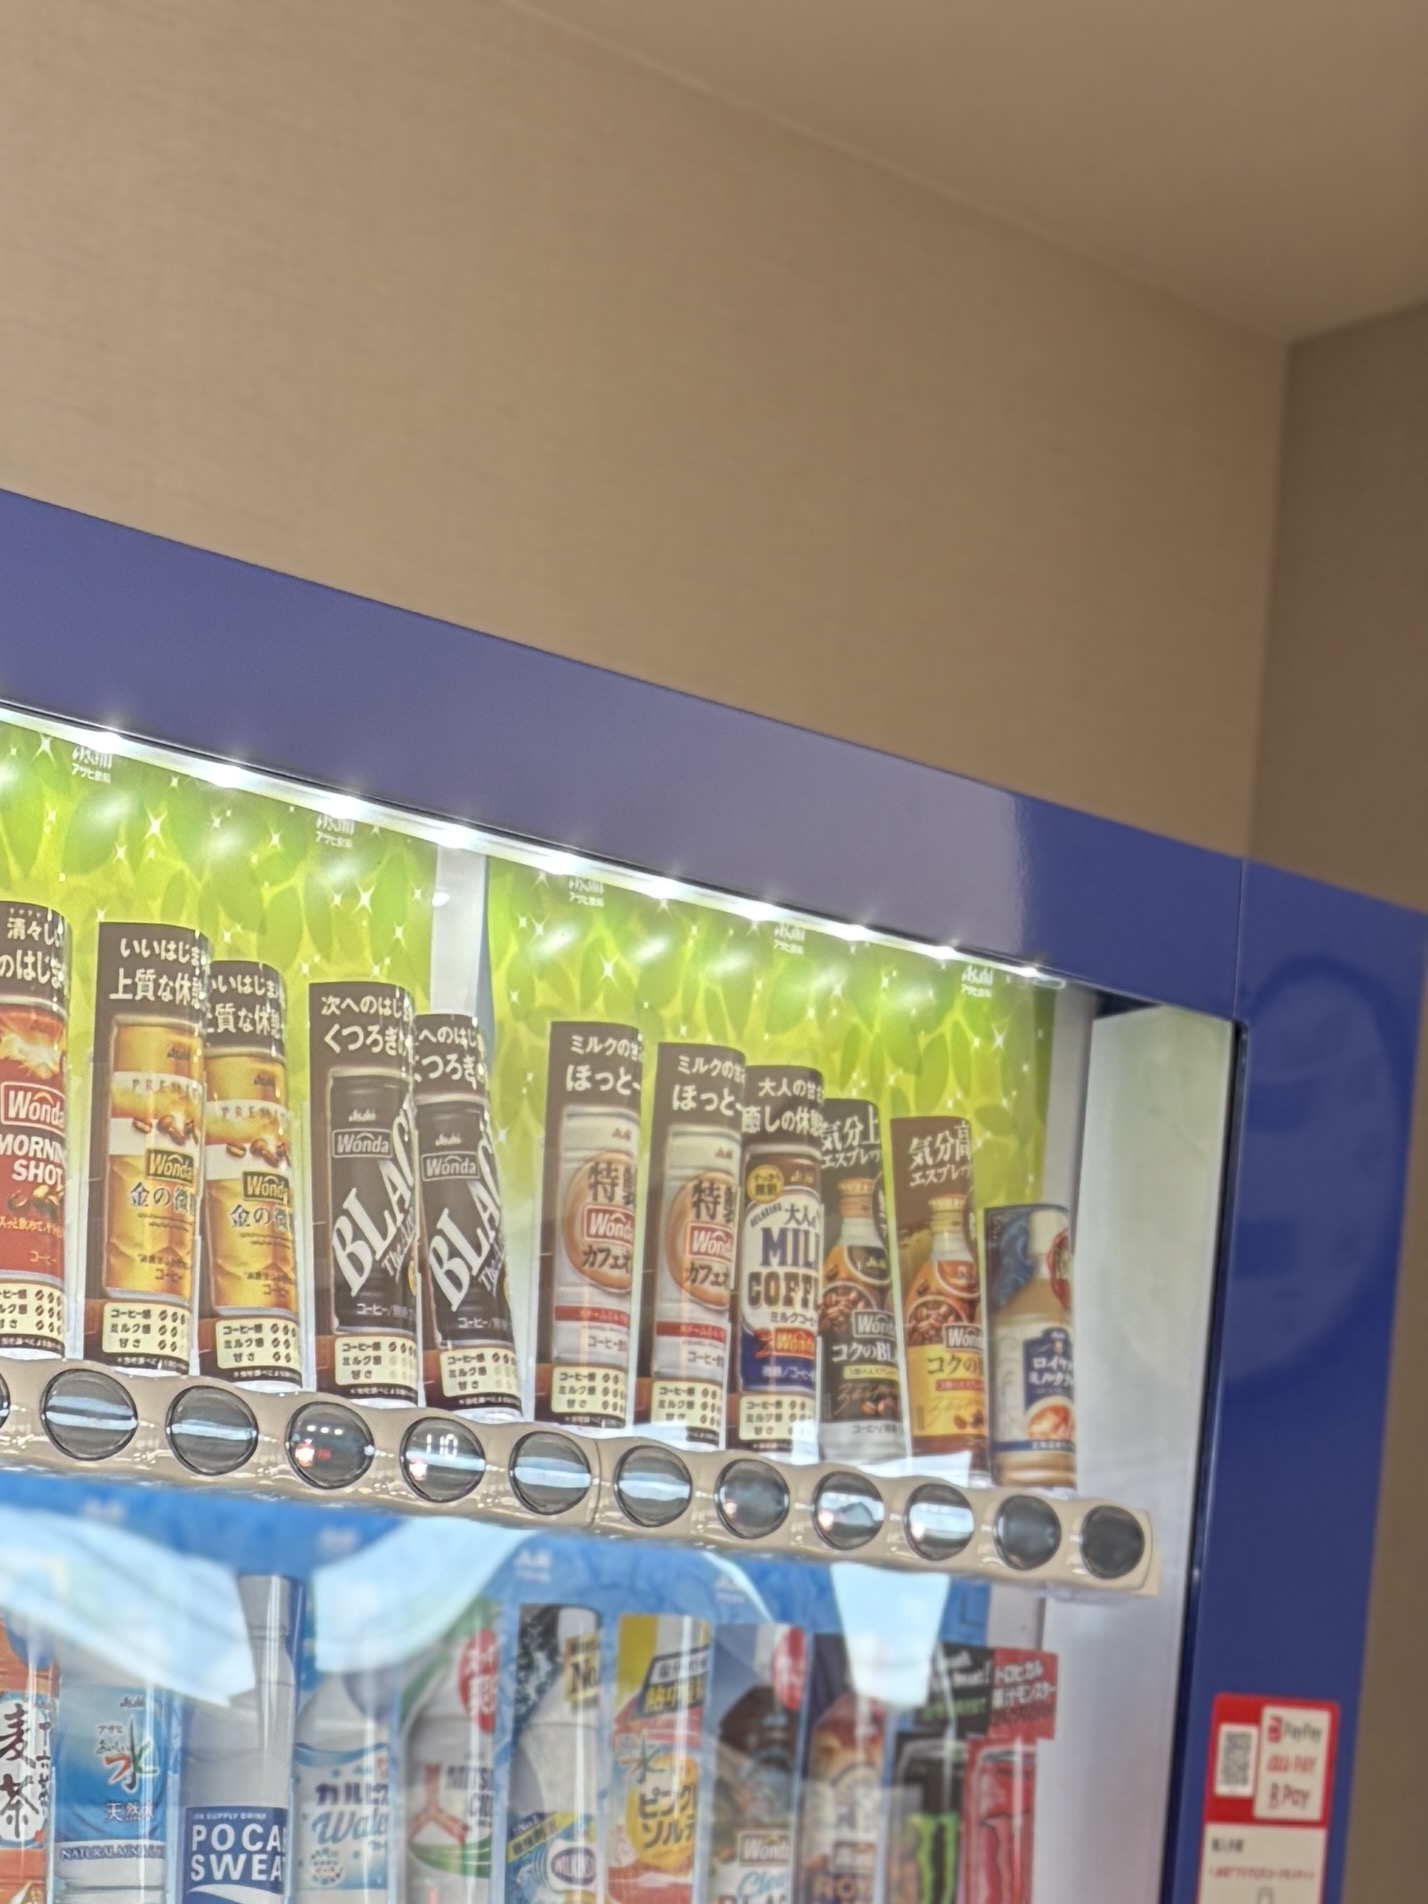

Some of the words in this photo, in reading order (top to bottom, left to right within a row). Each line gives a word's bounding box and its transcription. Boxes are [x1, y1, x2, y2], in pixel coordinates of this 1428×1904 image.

[821, 1104, 880, 1151] 気分上
[337, 1132, 389, 1154] Wonda
[12, 1159, 63, 1186] SHOT
[148, 1152, 193, 1182] Wonda
[425, 1159, 477, 1177] Wonda
[760, 1227, 819, 1267] MIL
[119, 1338, 141, 1348] 甘さ
[233, 1352, 255, 1362] 甘さ
[927, 1354, 977, 1375] コクの
[351, 1370, 372, 1379] 甘さ
[426, 1434, 458, 1460] 110
[104, 1713, 158, 1792] 水
[192, 1823, 285, 1852] POCA
